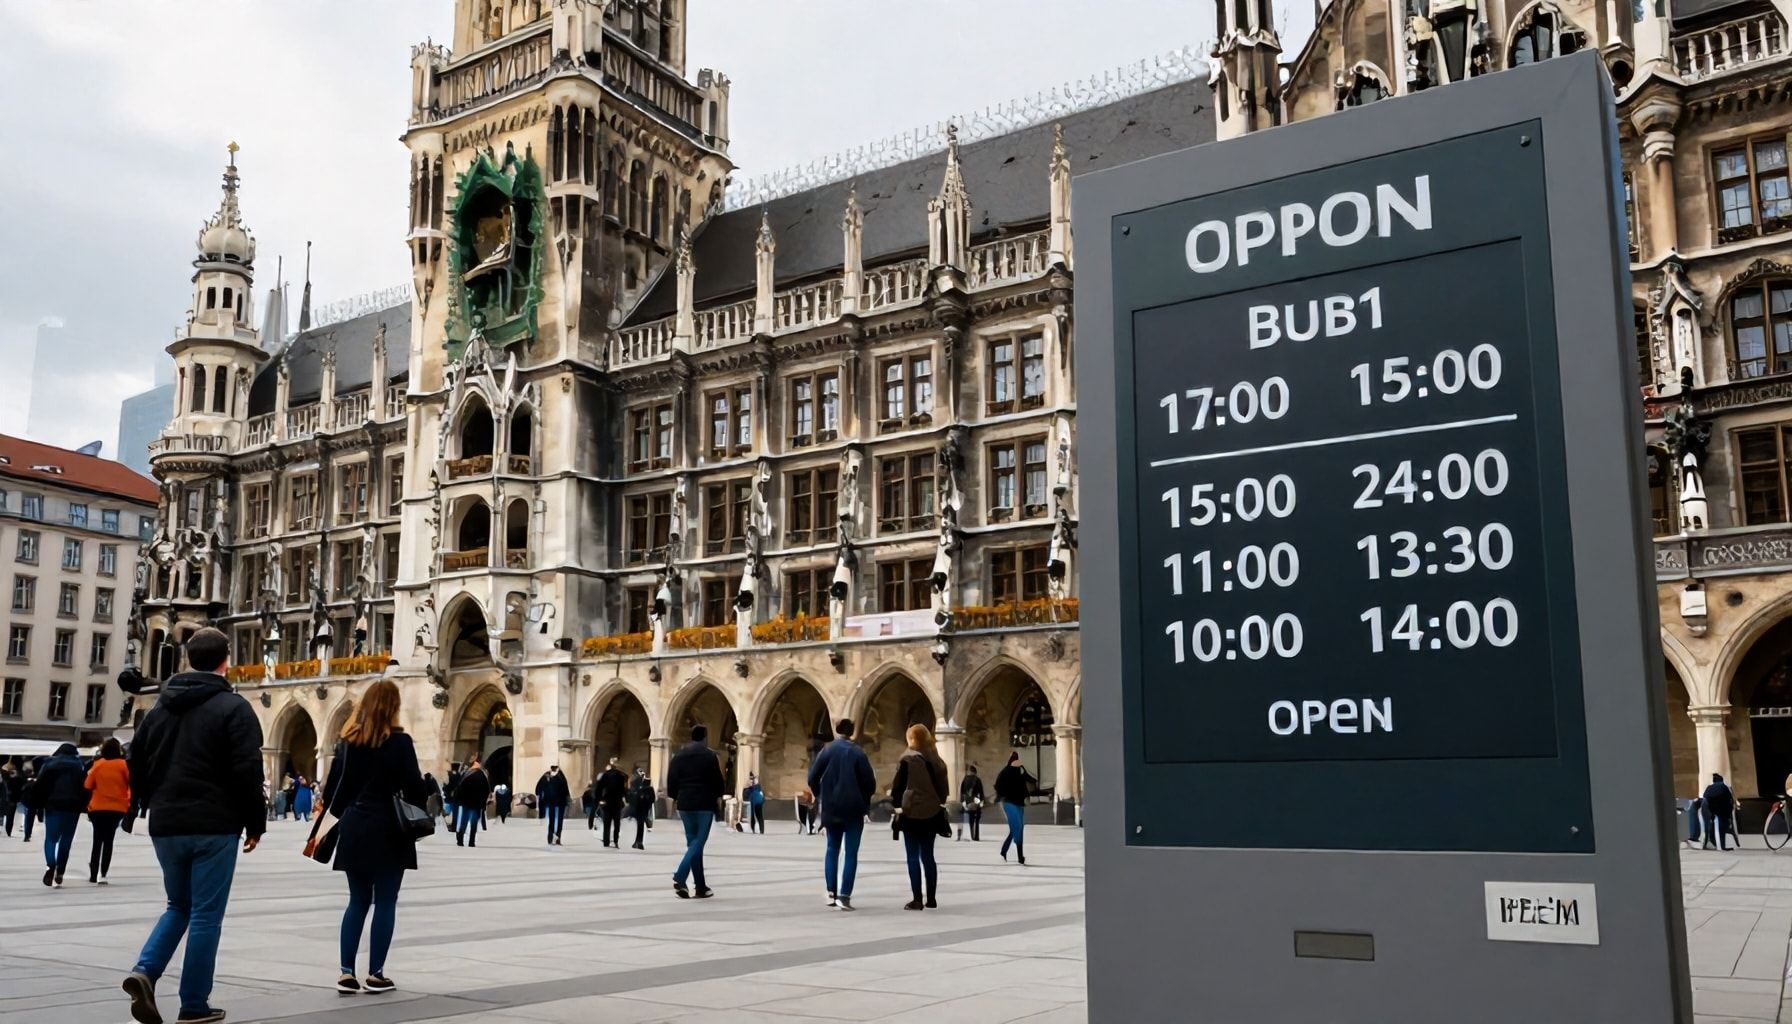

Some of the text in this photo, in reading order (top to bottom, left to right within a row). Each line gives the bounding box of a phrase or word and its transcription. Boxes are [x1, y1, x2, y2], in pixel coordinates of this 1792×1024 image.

[1185, 174, 1433, 274] OPPON
[1248, 286, 1383, 350] BUB1
[1159, 343, 1502, 434] 17:00 15:00
[1161, 448, 1509, 529] 15:00 24:00
[1163, 522, 1514, 595] 11:00 13:30
[1165, 597, 1518, 664] 10:00 14:00
